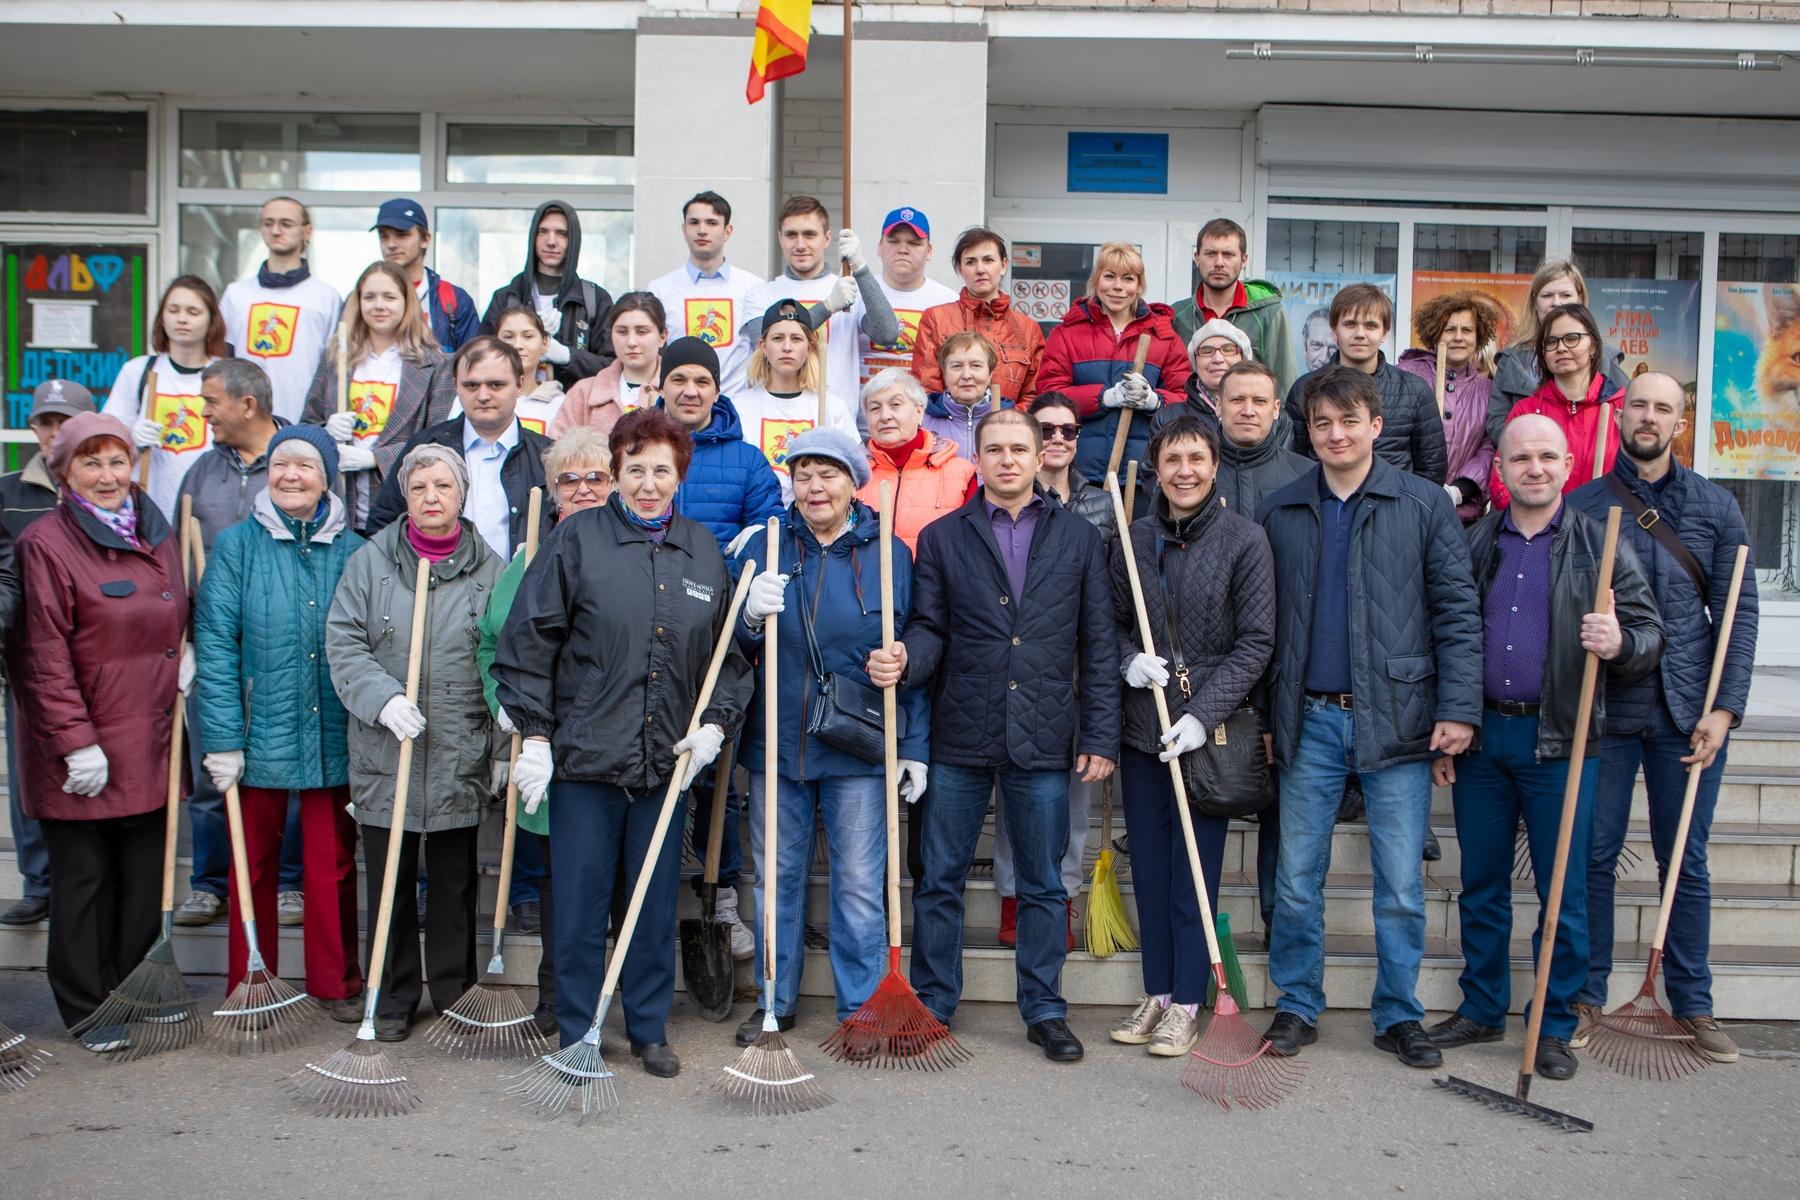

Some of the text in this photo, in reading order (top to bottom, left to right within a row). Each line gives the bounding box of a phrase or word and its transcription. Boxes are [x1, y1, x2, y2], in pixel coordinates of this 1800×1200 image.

[1615, 310, 1654, 327] МИА
[1609, 326, 1660, 339] И БЕЛЫЙ
[1619, 339, 1650, 355] ЛЕВ
